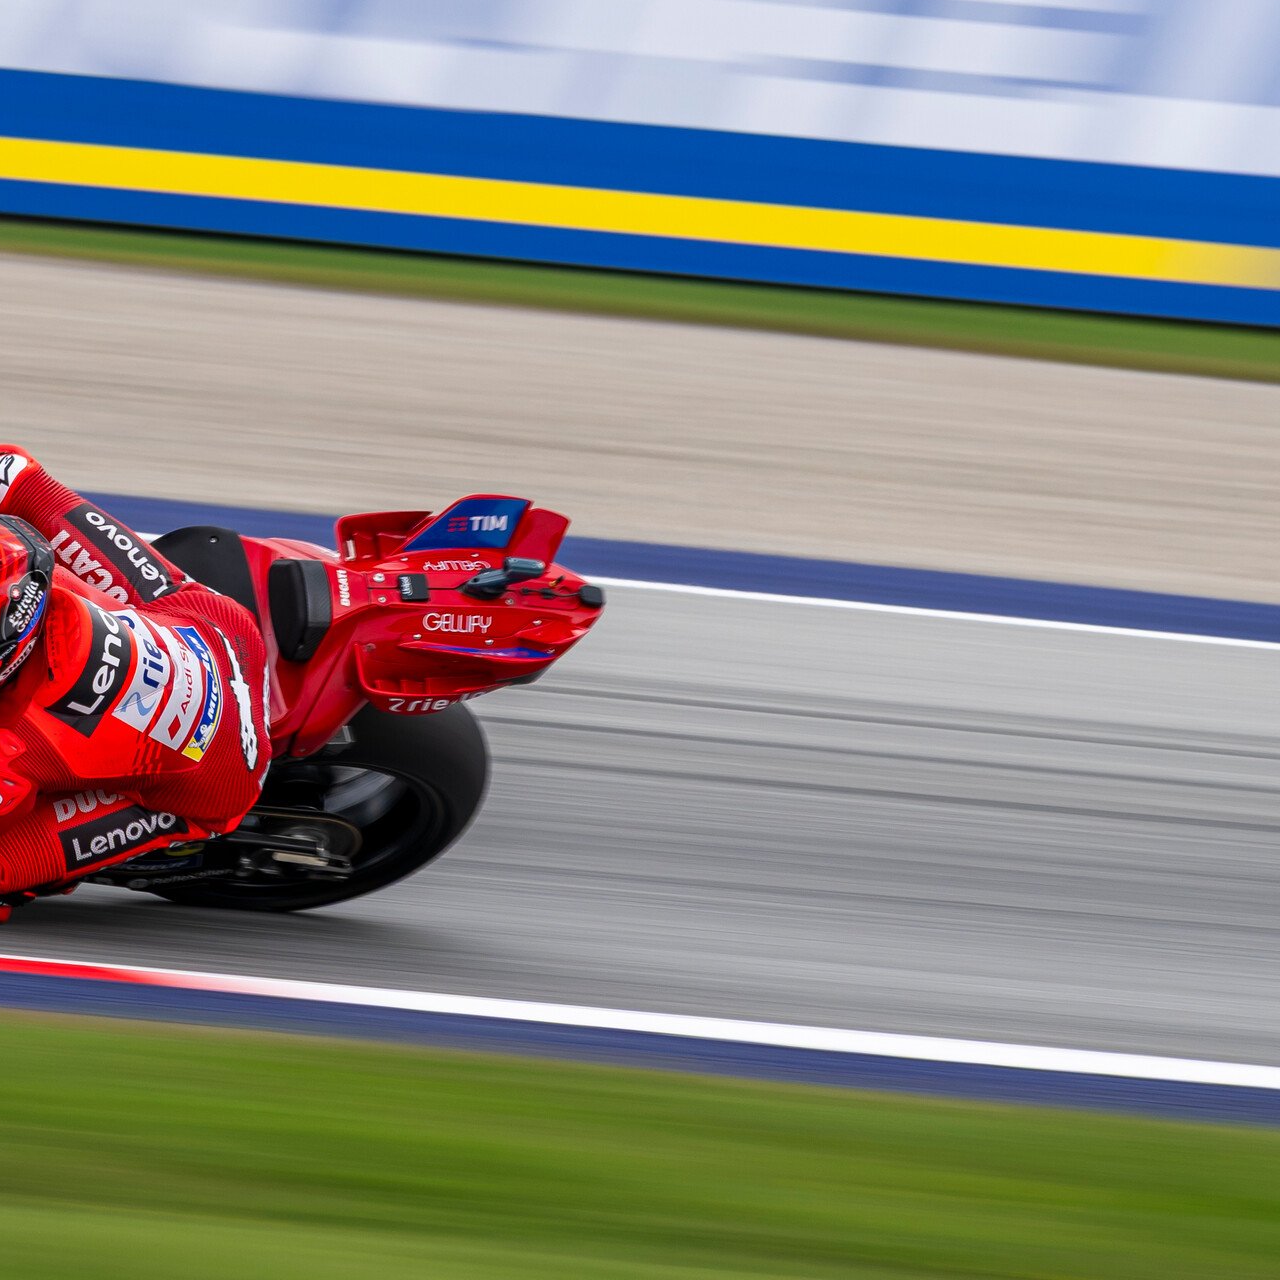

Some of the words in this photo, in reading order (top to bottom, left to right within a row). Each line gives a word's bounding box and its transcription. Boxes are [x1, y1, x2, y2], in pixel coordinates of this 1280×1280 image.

[470, 515, 508, 531] TIM
[50, 529, 134, 608] UCATI
[85, 511, 170, 598] Lenovo
[9, 581, 40, 627] Estrella
[336, 569, 350, 607] DUCATI
[67, 608, 122, 715] Leno
[181, 668, 196, 714] Audi
[72, 811, 176, 861] Lenovo
